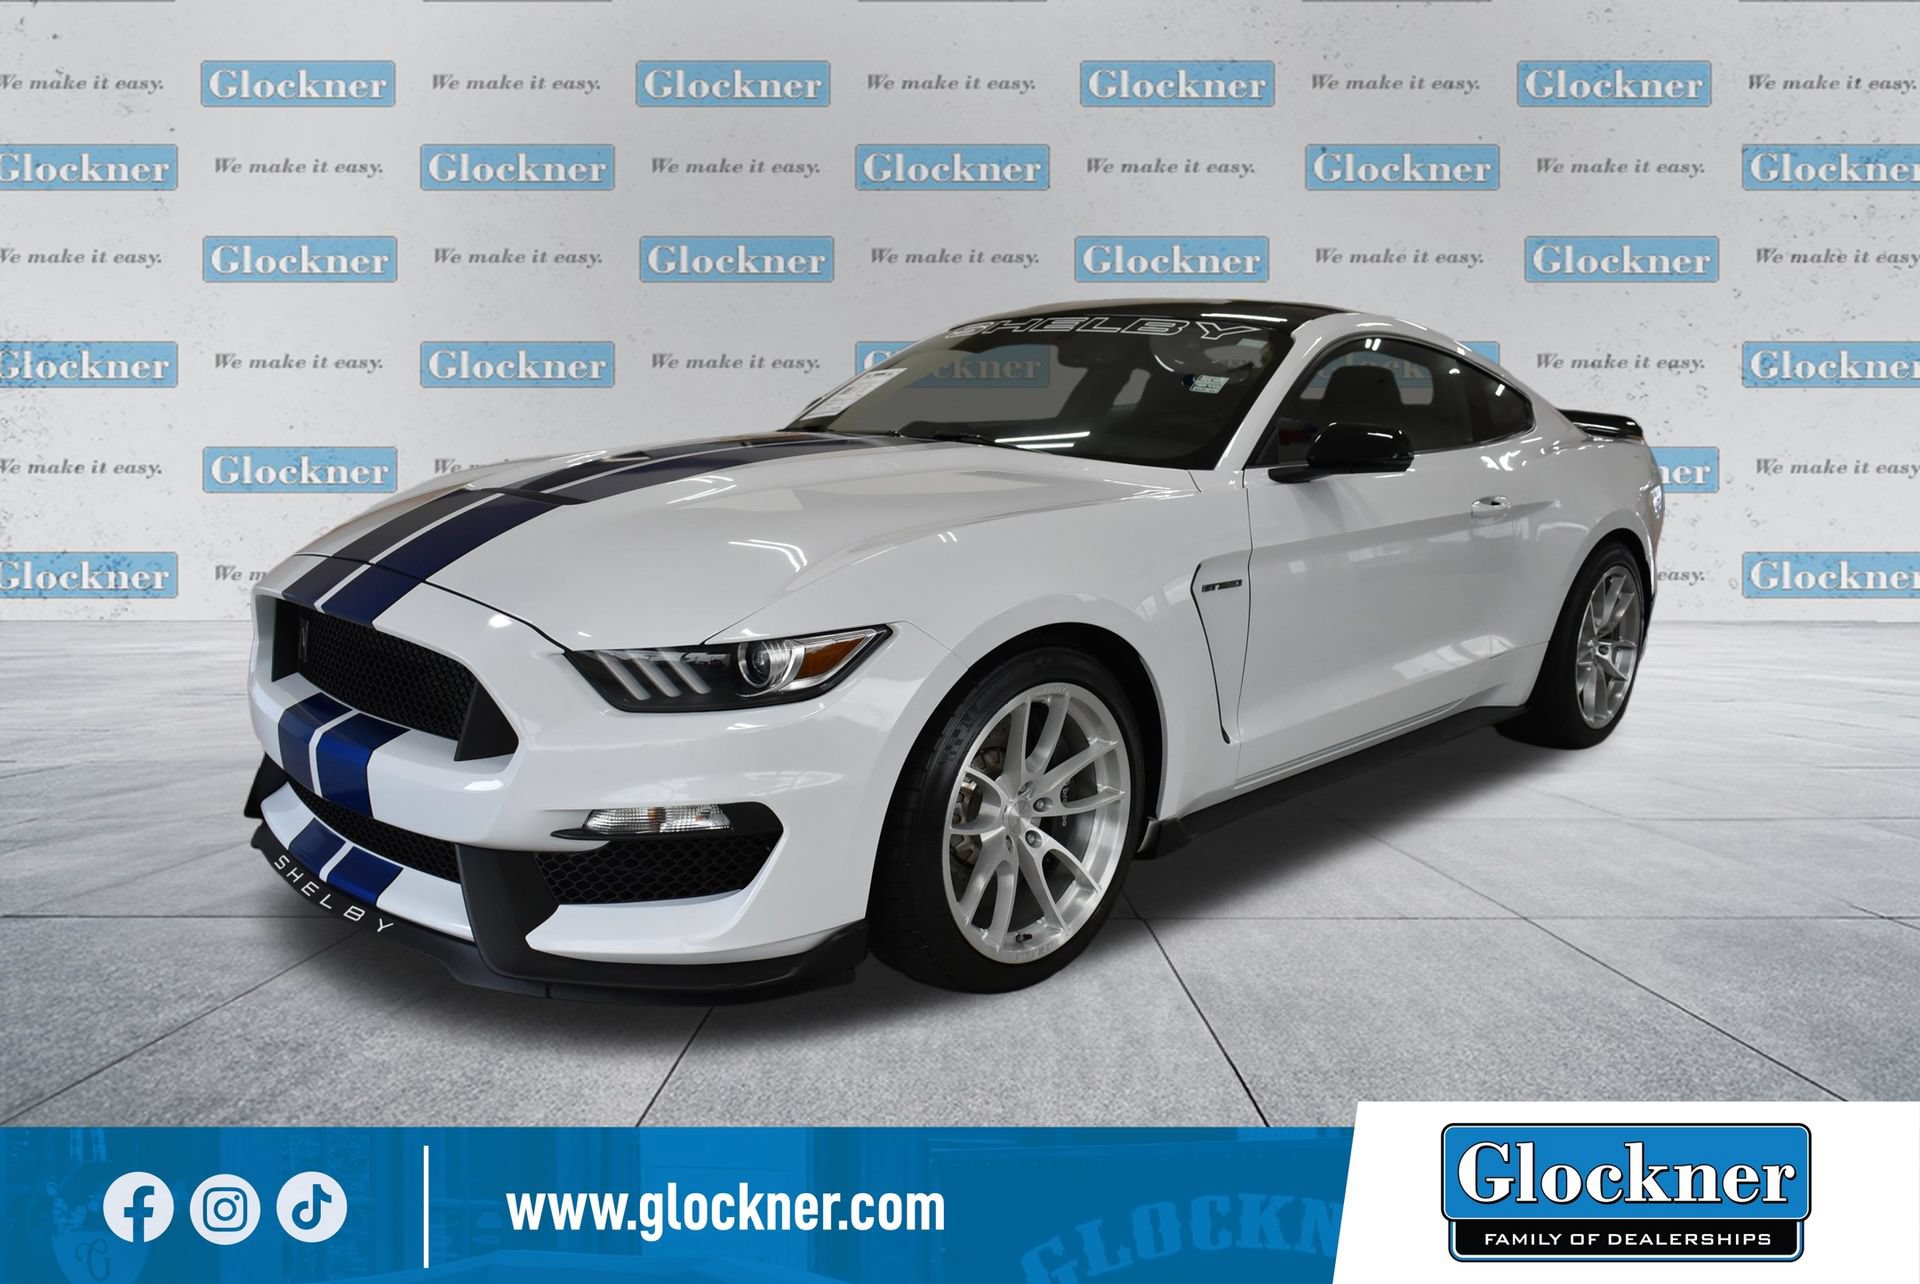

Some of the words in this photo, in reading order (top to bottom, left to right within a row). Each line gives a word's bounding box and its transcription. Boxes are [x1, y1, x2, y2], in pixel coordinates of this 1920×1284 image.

[30, 74, 87, 90] make
[93, 75, 109, 90] it
[114, 79, 164, 94] easy.
[209, 69, 388, 99] Glockner
[432, 74, 460, 90] We
[466, 74, 524, 90] make
[530, 75, 546, 90] it
[552, 79, 600, 94] easy.
[644, 69, 823, 99] Glockner
[867, 74, 894, 90] We
[902, 74, 959, 90] make
[965, 75, 981, 90] it
[986, 79, 1036, 94] easy.
[1088, 69, 1267, 99] Glockner
[1311, 74, 1338, 90] We
[1346, 74, 1403, 90] make
[1409, 75, 1425, 90] it
[1430, 79, 1480, 94] easy.
[1525, 69, 1704, 99] Glockner
[1748, 74, 1776, 90] We
[1782, 74, 1840, 90] make
[1846, 75, 1862, 90] it
[1868, 79, 1916, 94] easy.
[214, 158, 242, 174] We
[248, 158, 306, 174] make
[312, 159, 328, 174] it
[334, 163, 382, 178] easy.
[428, 153, 607, 183] Glockner
[651, 158, 678, 174] We
[686, 158, 743, 174] make
[749, 159, 765, 174] it
[770, 163, 820, 178] easy.
[863, 153, 1042, 183] Glockner
[1086, 158, 1114, 174] We
[1120, 158, 1178, 174] make
[1184, 159, 1200, 174] it
[1206, 163, 1254, 178] easy.
[1313, 153, 1492, 183] Glockner
[1536, 158, 1564, 174] We
[1570, 158, 1628, 174] make
[1634, 159, 1650, 174] it
[1656, 163, 1704, 178] easy.
[28, 248, 85, 264] make
[91, 249, 107, 264] it
[112, 253, 162, 268] easy.
[211, 244, 390, 274] Glockner
[434, 248, 462, 264] We
[468, 248, 526, 264] make
[532, 249, 548, 264] it
[554, 253, 602, 268] easy.
[648, 244, 827, 274] Glockner
[871, 248, 898, 264] We
[906, 248, 963, 264] make
[969, 249, 985, 264] it
[990, 253, 1040, 268] easy.
[1083, 244, 1262, 274] Glockner
[1315, 248, 1342, 264] We
[1350, 248, 1407, 264] make
[1413, 249, 1429, 264] it
[1434, 253, 1484, 268] easy.
[1533, 244, 1712, 274] Glockner
[1756, 248, 1784, 264] We
[1790, 248, 1848, 264] make
[1854, 249, 1870, 264] it
[1876, 253, 1920, 268] easy
[945, 316, 1262, 341] SHELBY
[214, 353, 242, 369] We
[248, 353, 306, 369] make
[312, 354, 328, 369] it
[334, 358, 382, 374] easy.
[428, 350, 607, 380] Glockner
[651, 353, 678, 369] We
[686, 353, 743, 369] make
[749, 354, 765, 369] it
[770, 358, 820, 374] easy.
[1536, 353, 1564, 369] We
[1570, 353, 1628, 369] make
[1634, 354, 1650, 369] it
[1656, 358, 1704, 374] easy.
[28, 458, 85, 474] make
[91, 459, 107, 474] it
[112, 463, 162, 478] easy.
[211, 455, 390, 485] Glockner
[434, 458, 461, 474] We
[1756, 458, 1784, 474] We
[1790, 458, 1848, 474] make
[1854, 459, 1870, 474] it
[1876, 463, 1920, 478] easy
[214, 564, 242, 581] We
[1657, 569, 1705, 586] easy.
[273, 854, 395, 933] SHELBY
